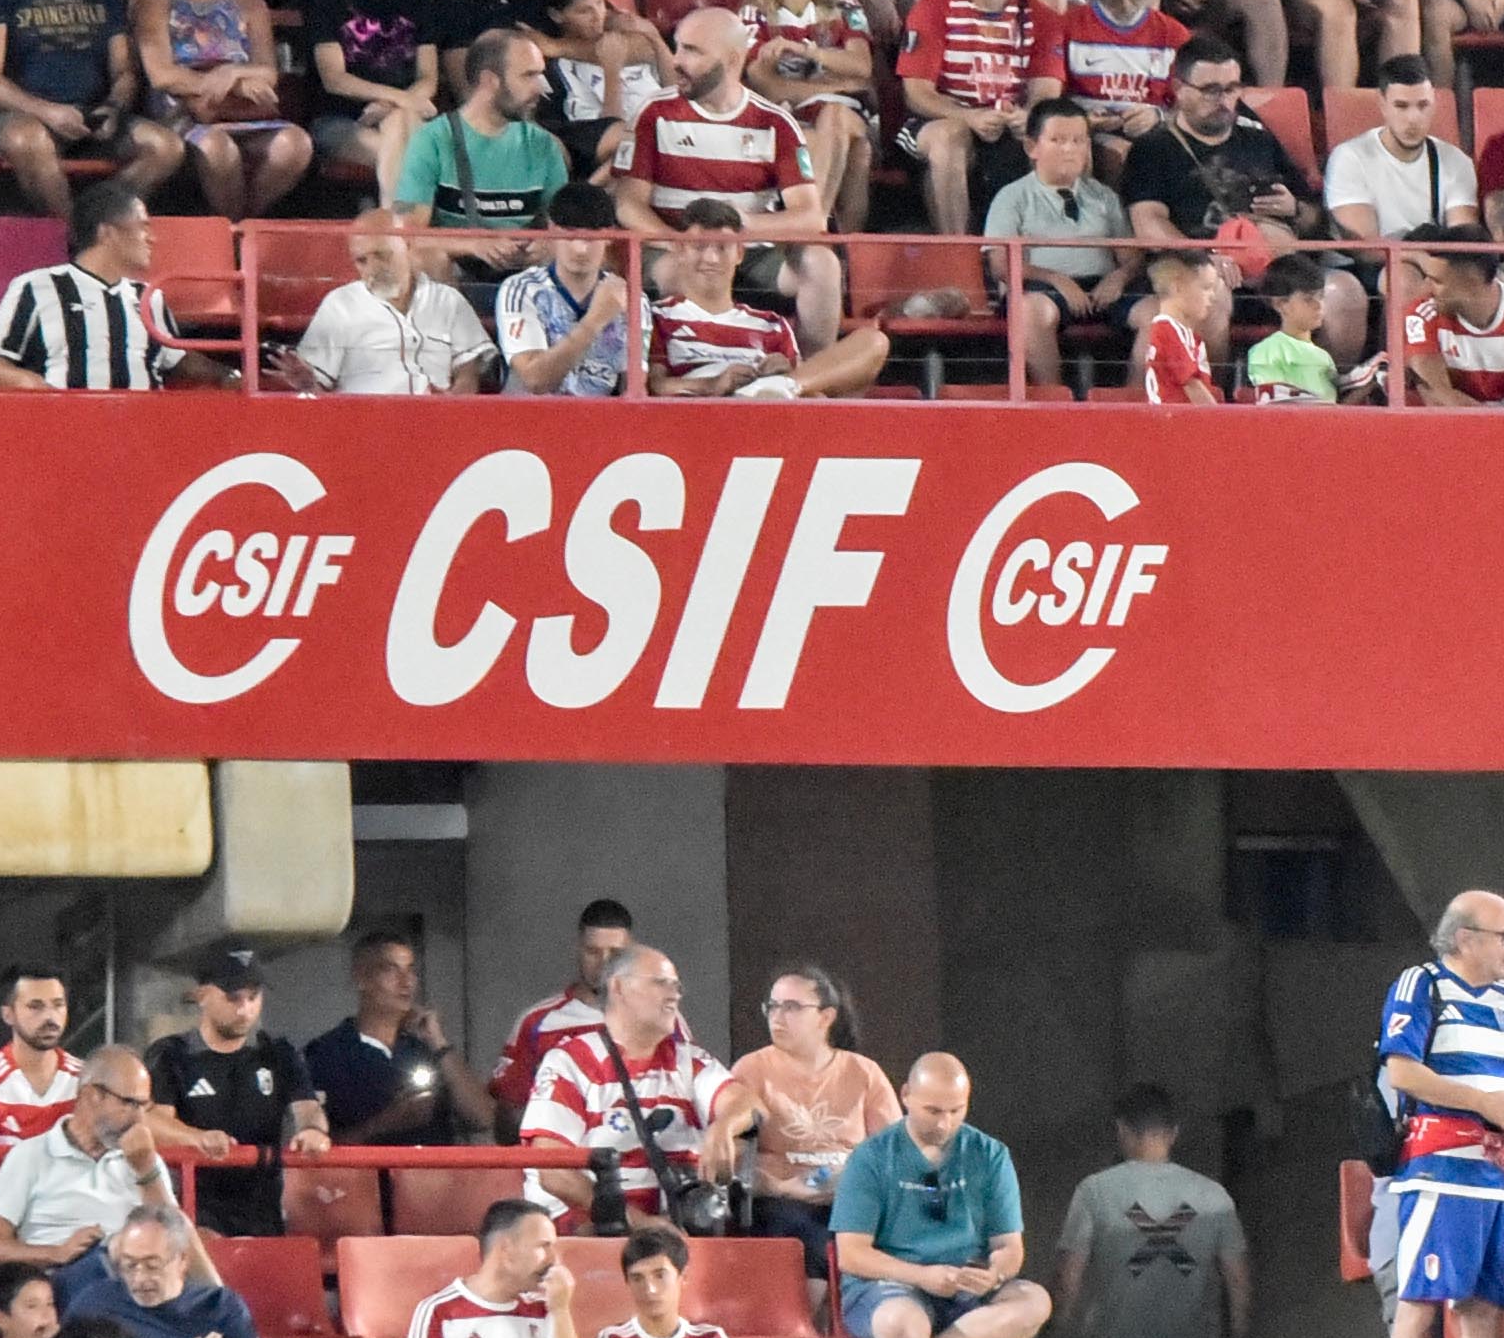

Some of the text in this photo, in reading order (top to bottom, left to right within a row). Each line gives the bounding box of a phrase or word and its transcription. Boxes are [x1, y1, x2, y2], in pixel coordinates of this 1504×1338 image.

[15, 3, 104, 28] SPRINGFIELD
[173, 528, 356, 618] CSIF
[386, 450, 923, 710] CSIF
[991, 538, 1169, 628] CSIF
